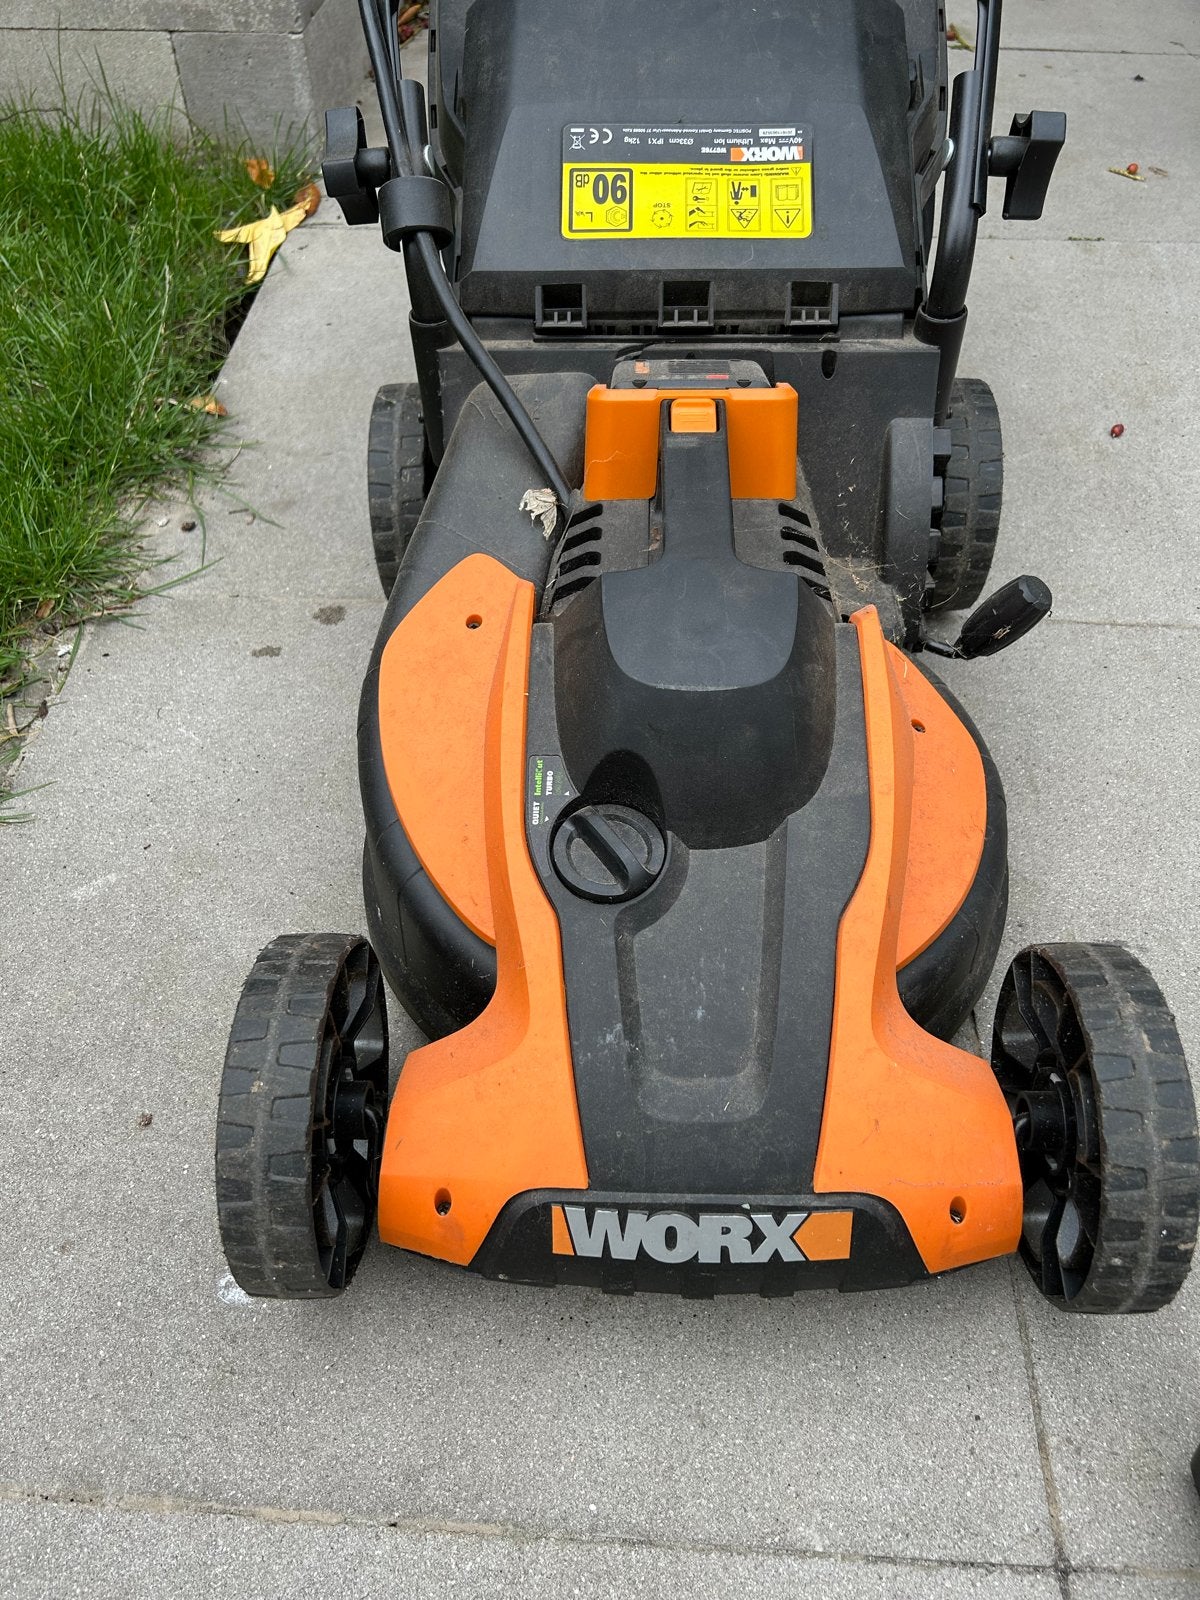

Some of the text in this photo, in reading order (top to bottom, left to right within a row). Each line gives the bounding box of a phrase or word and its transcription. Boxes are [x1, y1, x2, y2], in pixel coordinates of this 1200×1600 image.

[624, 136, 640, 144] 12kg
[740, 146, 798, 161] WORX
[575, 174, 590, 187] dB
[592, 174, 627, 205] 90
[563, 1205, 808, 1264] WORX
